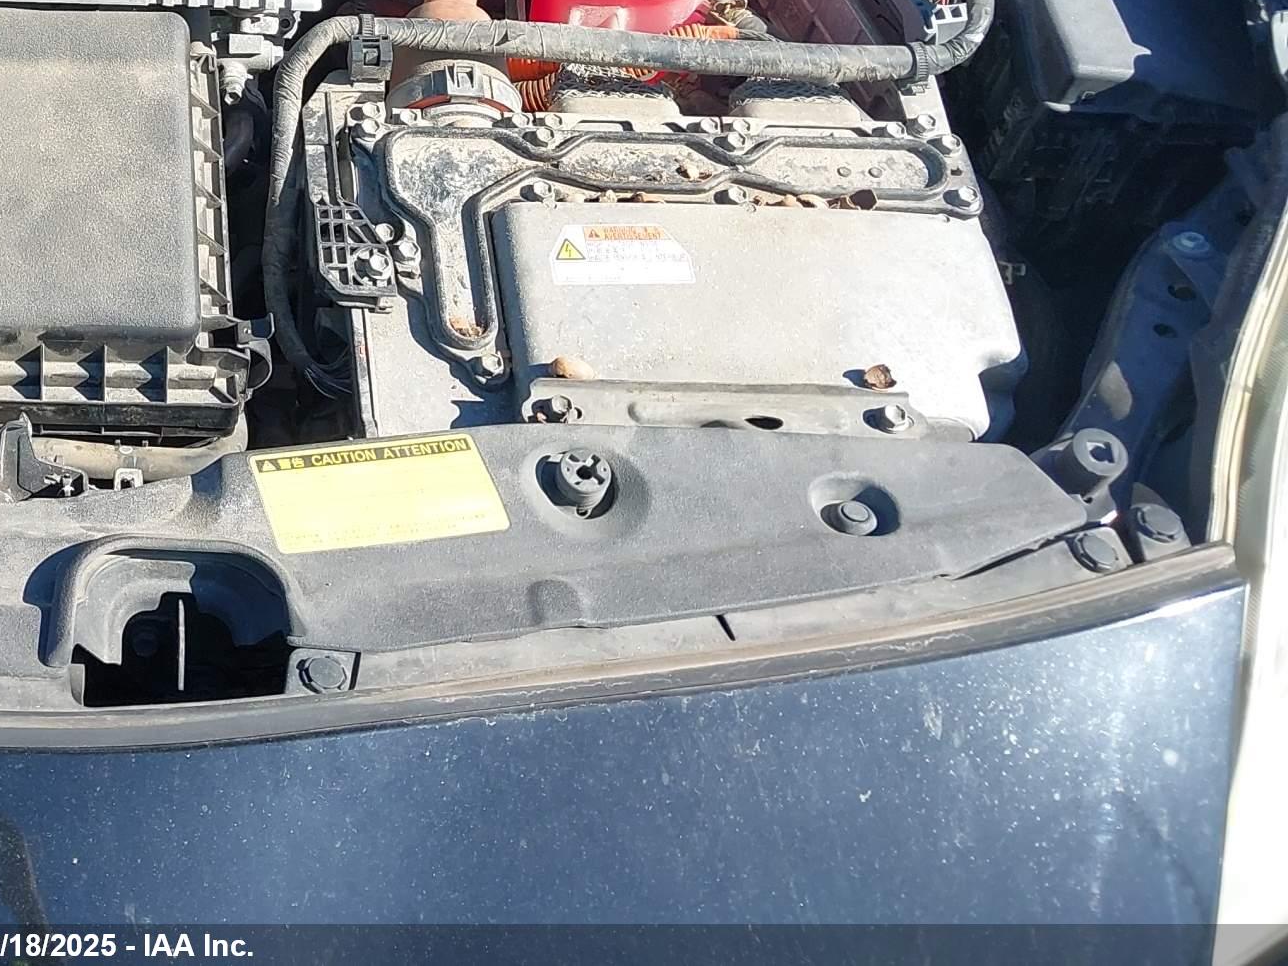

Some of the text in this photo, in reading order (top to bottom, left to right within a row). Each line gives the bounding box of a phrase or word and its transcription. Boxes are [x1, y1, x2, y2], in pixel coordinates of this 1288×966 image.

[604, 232, 661, 240] AVERTISSEMENT
[310, 449, 377, 467] CAUTION
[382, 439, 468, 459] ATTENTION
